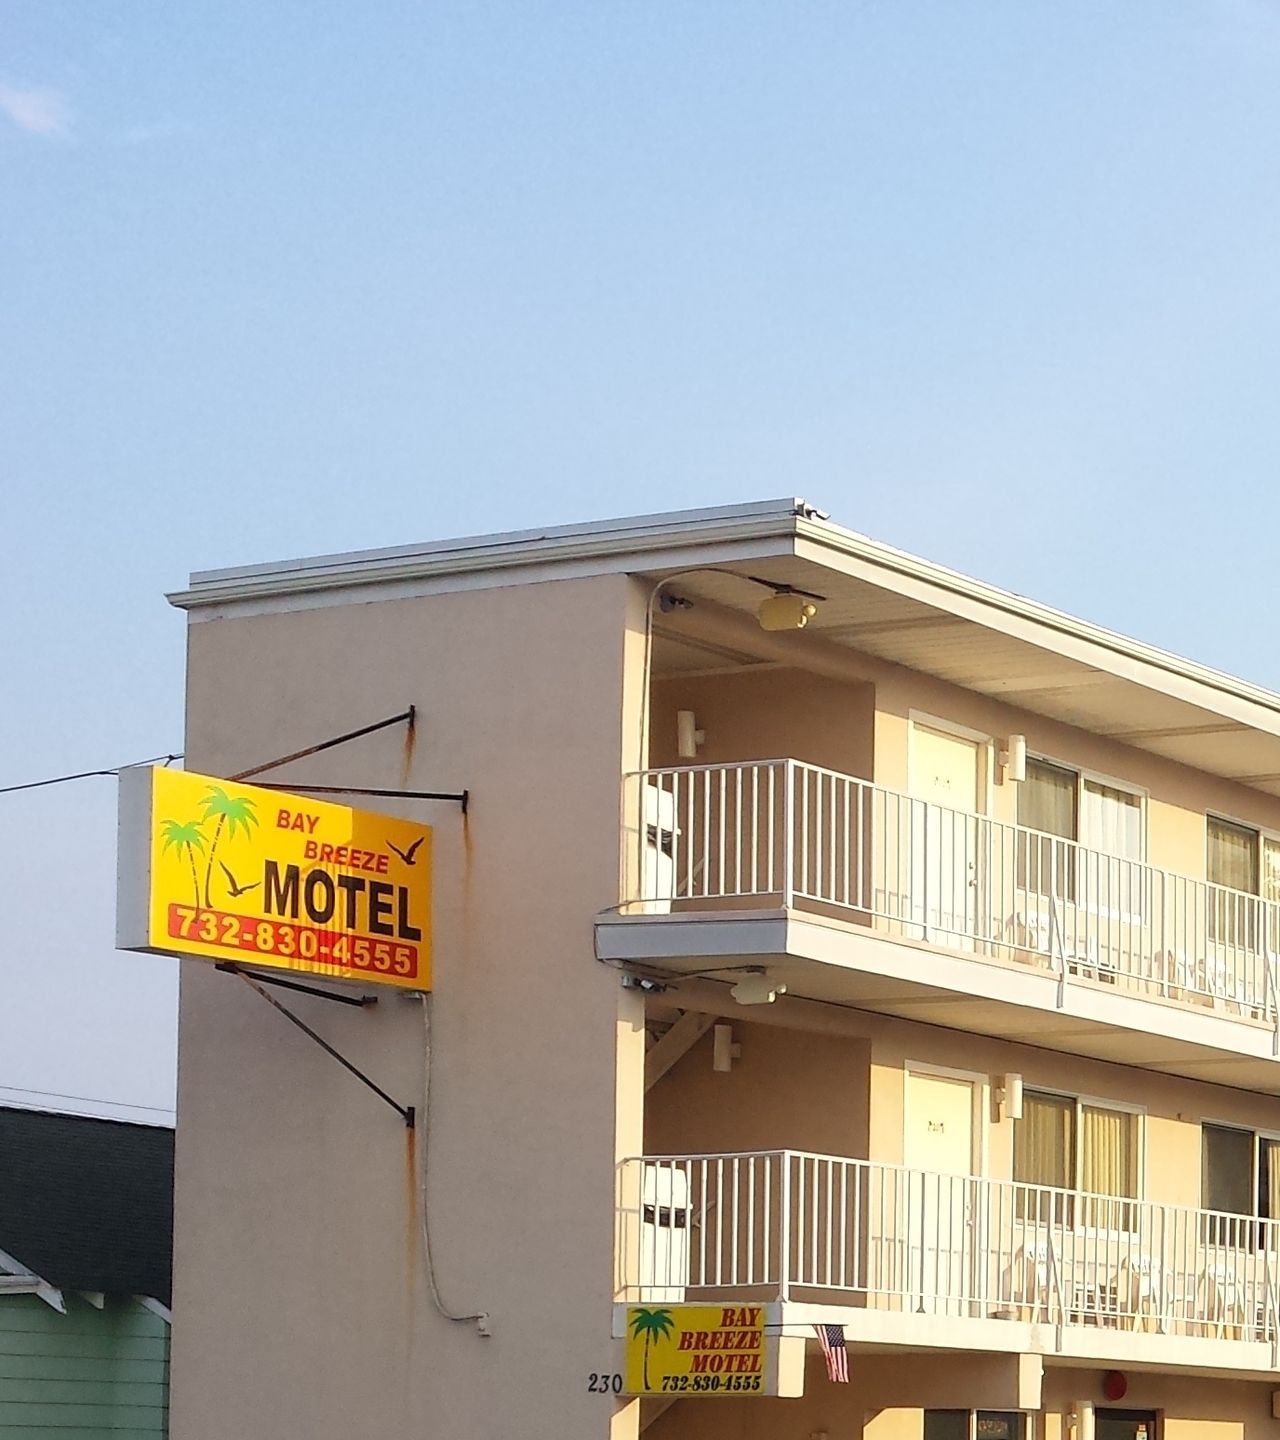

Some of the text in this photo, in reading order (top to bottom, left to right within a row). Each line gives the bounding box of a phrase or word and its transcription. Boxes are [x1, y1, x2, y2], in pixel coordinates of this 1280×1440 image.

[277, 809, 320, 834] BAY
[304, 840, 389, 875] BREEZE
[263, 859, 422, 941] MOTEL
[176, 908, 411, 975] 732-830-4555
[719, 1308, 762, 1328] BAY
[677, 1331, 762, 1350] BREEZE
[689, 1354, 762, 1373] MOTEL
[587, 1373, 623, 1393] 230
[661, 1375, 762, 1392] 732-830-4555
